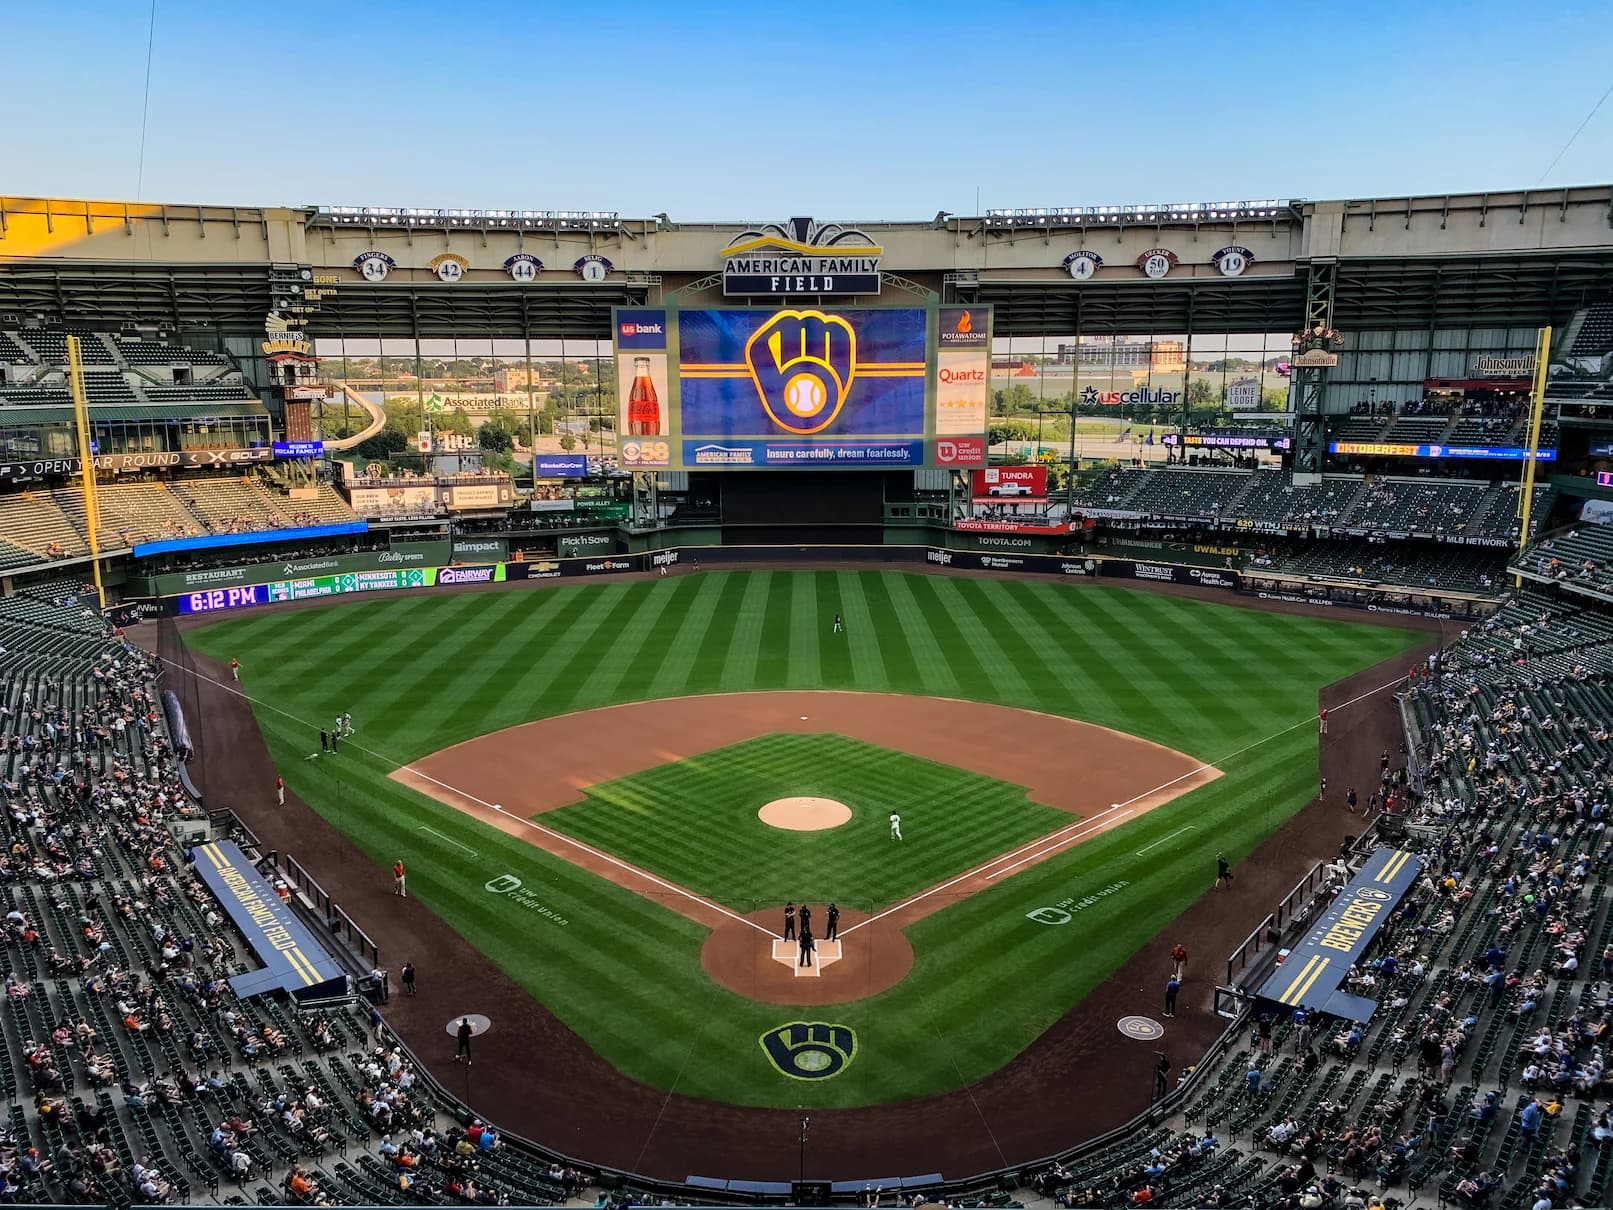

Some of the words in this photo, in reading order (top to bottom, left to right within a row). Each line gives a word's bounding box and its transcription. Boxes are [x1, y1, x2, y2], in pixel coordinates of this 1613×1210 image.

[1222, 246, 1246, 256] YOUNT
[366, 263, 384, 276] 34
[726, 259, 812, 273] AMERICAN
[820, 258, 879, 272] FAMILY
[1076, 262, 1086, 274] 4
[1149, 257, 1165, 270] 50
[1224, 257, 1241, 273] 19
[442, 264, 460, 276] 42
[515, 266, 532, 278] 44
[591, 266, 597, 279] 1
[313, 276, 342, 284] GONE!
[771, 276, 833, 292] FIELD
[636, 324, 662, 334] bank
[269, 332, 304, 341] BERNIE'S
[262, 339, 312, 354] CHALET
[939, 368, 984, 384] Quartz
[1230, 388, 1256, 396] LEINIE
[1230, 396, 1255, 404] LODGE
[1184, 436, 1202, 444] TASTE
[1230, 438, 1256, 446] DEPEND
[640, 441, 670, 460] 58
[766, 448, 794, 458] Insure
[796, 448, 830, 460] carefully,
[832, 448, 858, 458] dream
[861, 447, 914, 460] fearlessly.
[1336, 444, 1418, 456] OKTOBERFEST
[34, 460, 72, 474] OPEN
[123, 453, 180, 466] ROUND
[230, 450, 268, 460] GOLF
[983, 522, 1018, 531] TERRITORY
[1236, 520, 1254, 528] 620
[1254, 521, 1280, 530] WTMJ
[588, 535, 610, 544] Save
[978, 536, 1032, 546] TOYOTA.COM
[1446, 536, 1462, 544] MLB
[1466, 536, 1508, 547] NETWORK
[462, 540, 500, 552] impact
[1194, 544, 1240, 556] UWM.EDU
[378, 552, 404, 564] Bally
[404, 554, 424, 562] SPORTS
[654, 550, 678, 566] meijer
[928, 550, 952, 565] meijer
[186, 568, 244, 582] RESTAURANT
[456, 568, 493, 580] FAIRWAY
[1136, 564, 1174, 574] WINTRUST
[359, 572, 398, 581] MINNESOTA
[1200, 577, 1220, 586] Health
[294, 580, 315, 588] MIAMI
[190, 590, 224, 611] 6:12
[230, 587, 256, 606] PM
[1070, 896, 1101, 912] credit
[1098, 880, 1130, 896] union
[217, 866, 256, 906] AMERICAN
[242, 900, 280, 932] FAMILY
[263, 924, 296, 952] FIELD
[508, 892, 540, 909] credit
[537, 906, 569, 926] union
[1320, 899, 1382, 952] BREWERS
